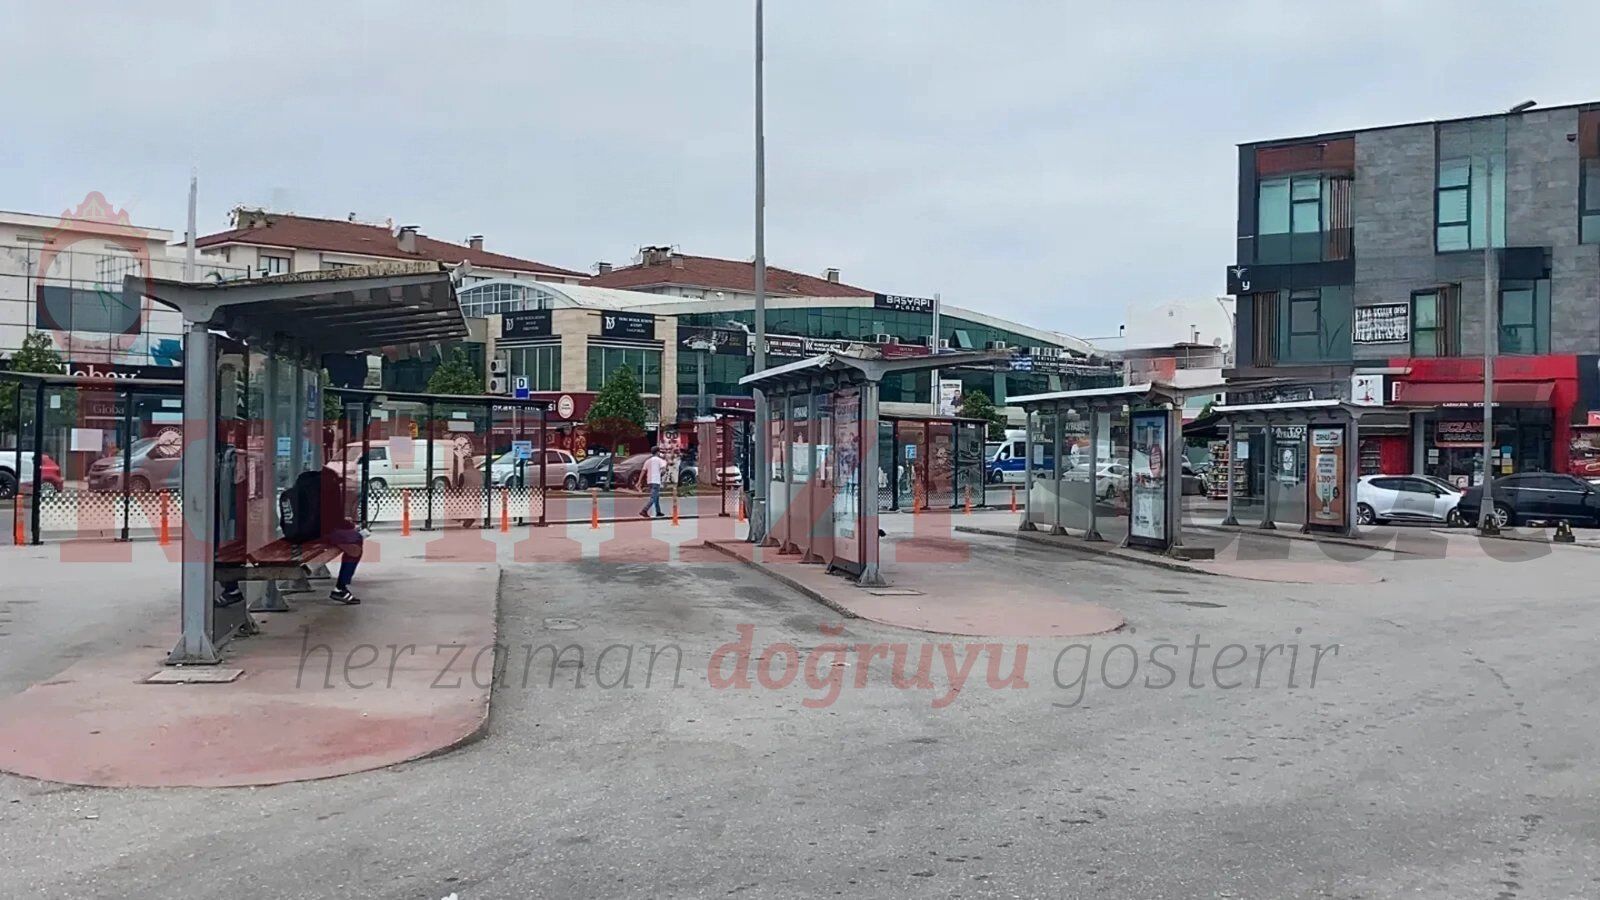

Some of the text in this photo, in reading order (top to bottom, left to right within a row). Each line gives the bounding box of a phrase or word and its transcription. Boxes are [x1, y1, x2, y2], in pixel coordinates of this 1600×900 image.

[895, 304, 921, 312] PLAZA
[518, 378, 525, 388] D
[1438, 421, 1485, 433] ECZAN
